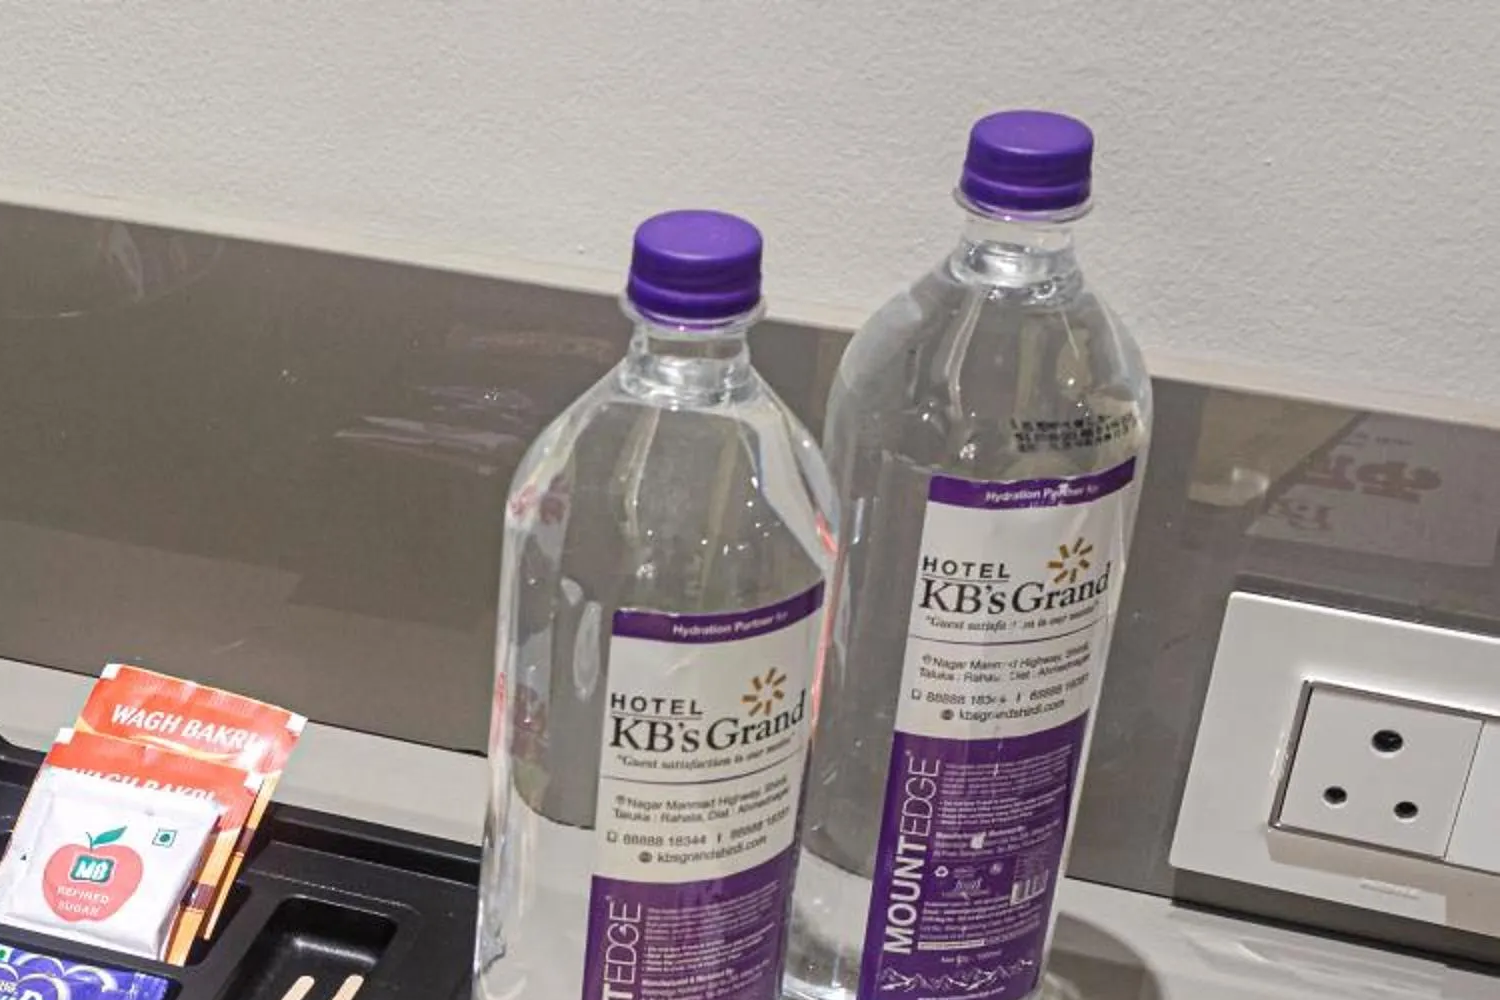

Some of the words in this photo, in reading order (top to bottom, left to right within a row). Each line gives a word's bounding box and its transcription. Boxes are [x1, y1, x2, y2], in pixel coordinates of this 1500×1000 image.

[922, 556, 1010, 579] HOTEL
[919, 580, 1005, 615] KB's
[1011, 561, 1111, 613] Grand
[673, 624, 732, 638] Hydration
[111, 703, 184, 736] WAGH
[609, 716, 699, 752] KB's
[707, 688, 806, 750] Grand
[610, 693, 703, 715] HOTEL
[883, 756, 940, 954] MOUNTEDGE
